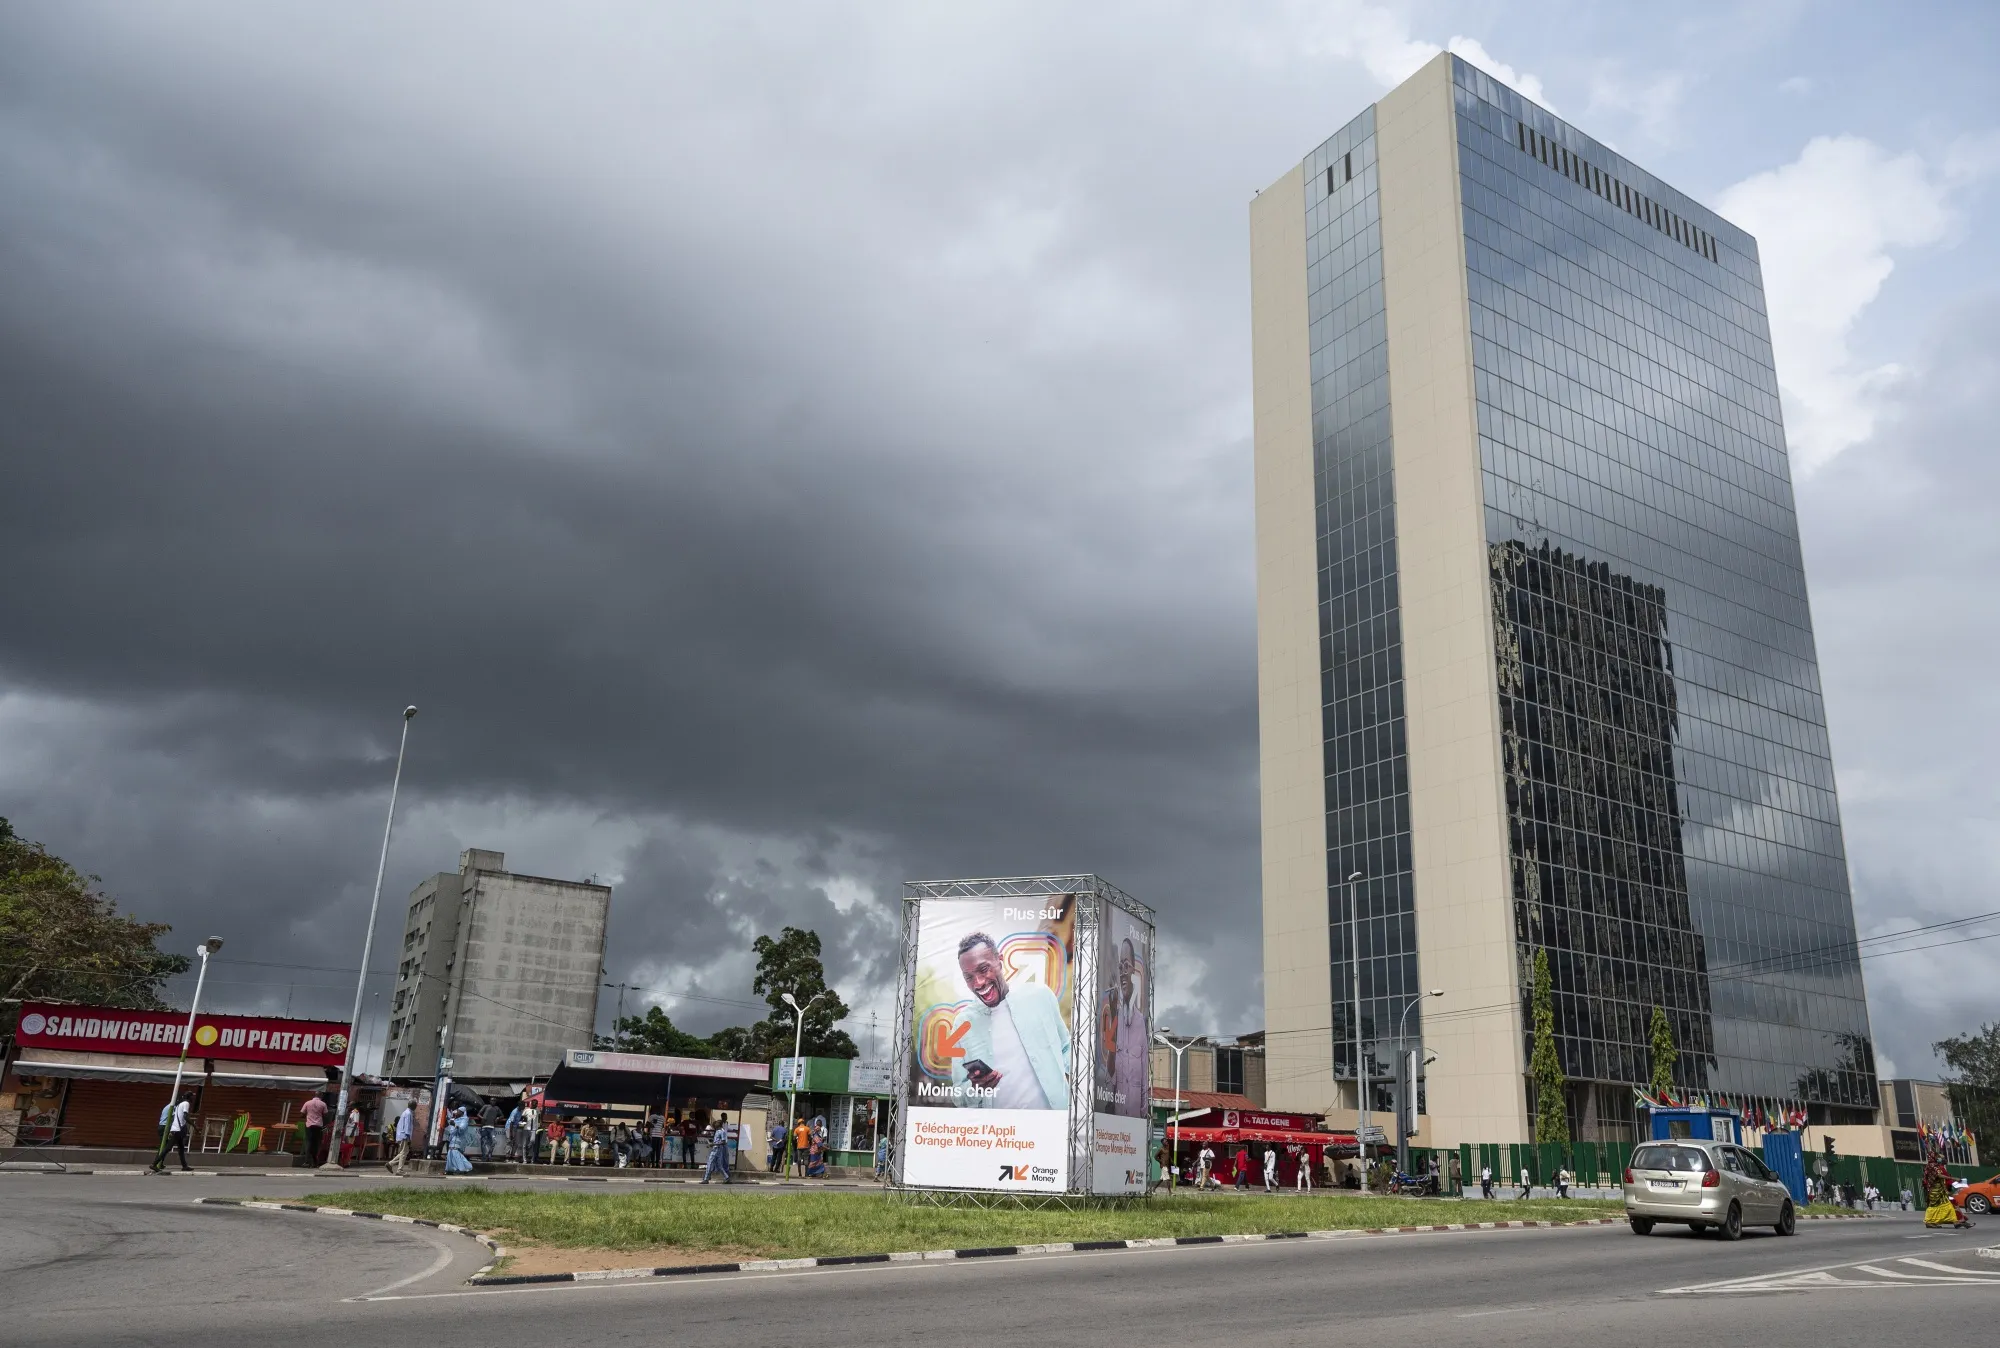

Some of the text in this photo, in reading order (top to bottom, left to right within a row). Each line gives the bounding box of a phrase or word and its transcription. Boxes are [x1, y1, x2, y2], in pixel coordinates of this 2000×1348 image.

[1003, 905, 1064, 921] Plus sûr
[1129, 924, 1140, 941] Plus
[219, 1028, 247, 1047] DU
[247, 1029, 328, 1053] PLATEAU
[917, 1081, 1000, 1098] Moins cher
[1096, 1085, 1127, 1105] Moins cher
[1251, 1116, 1270, 1126] TATA
[1270, 1118, 1290, 1127] GENE
[914, 1122, 1016, 1138] Téléchargez l'Appli
[914, 1135, 1035, 1151] Orange Money Afrique
[1095, 1141, 1110, 1155] Orange
[1032, 1166, 1059, 1175] Orange
[1031, 1174, 1056, 1184] Money
